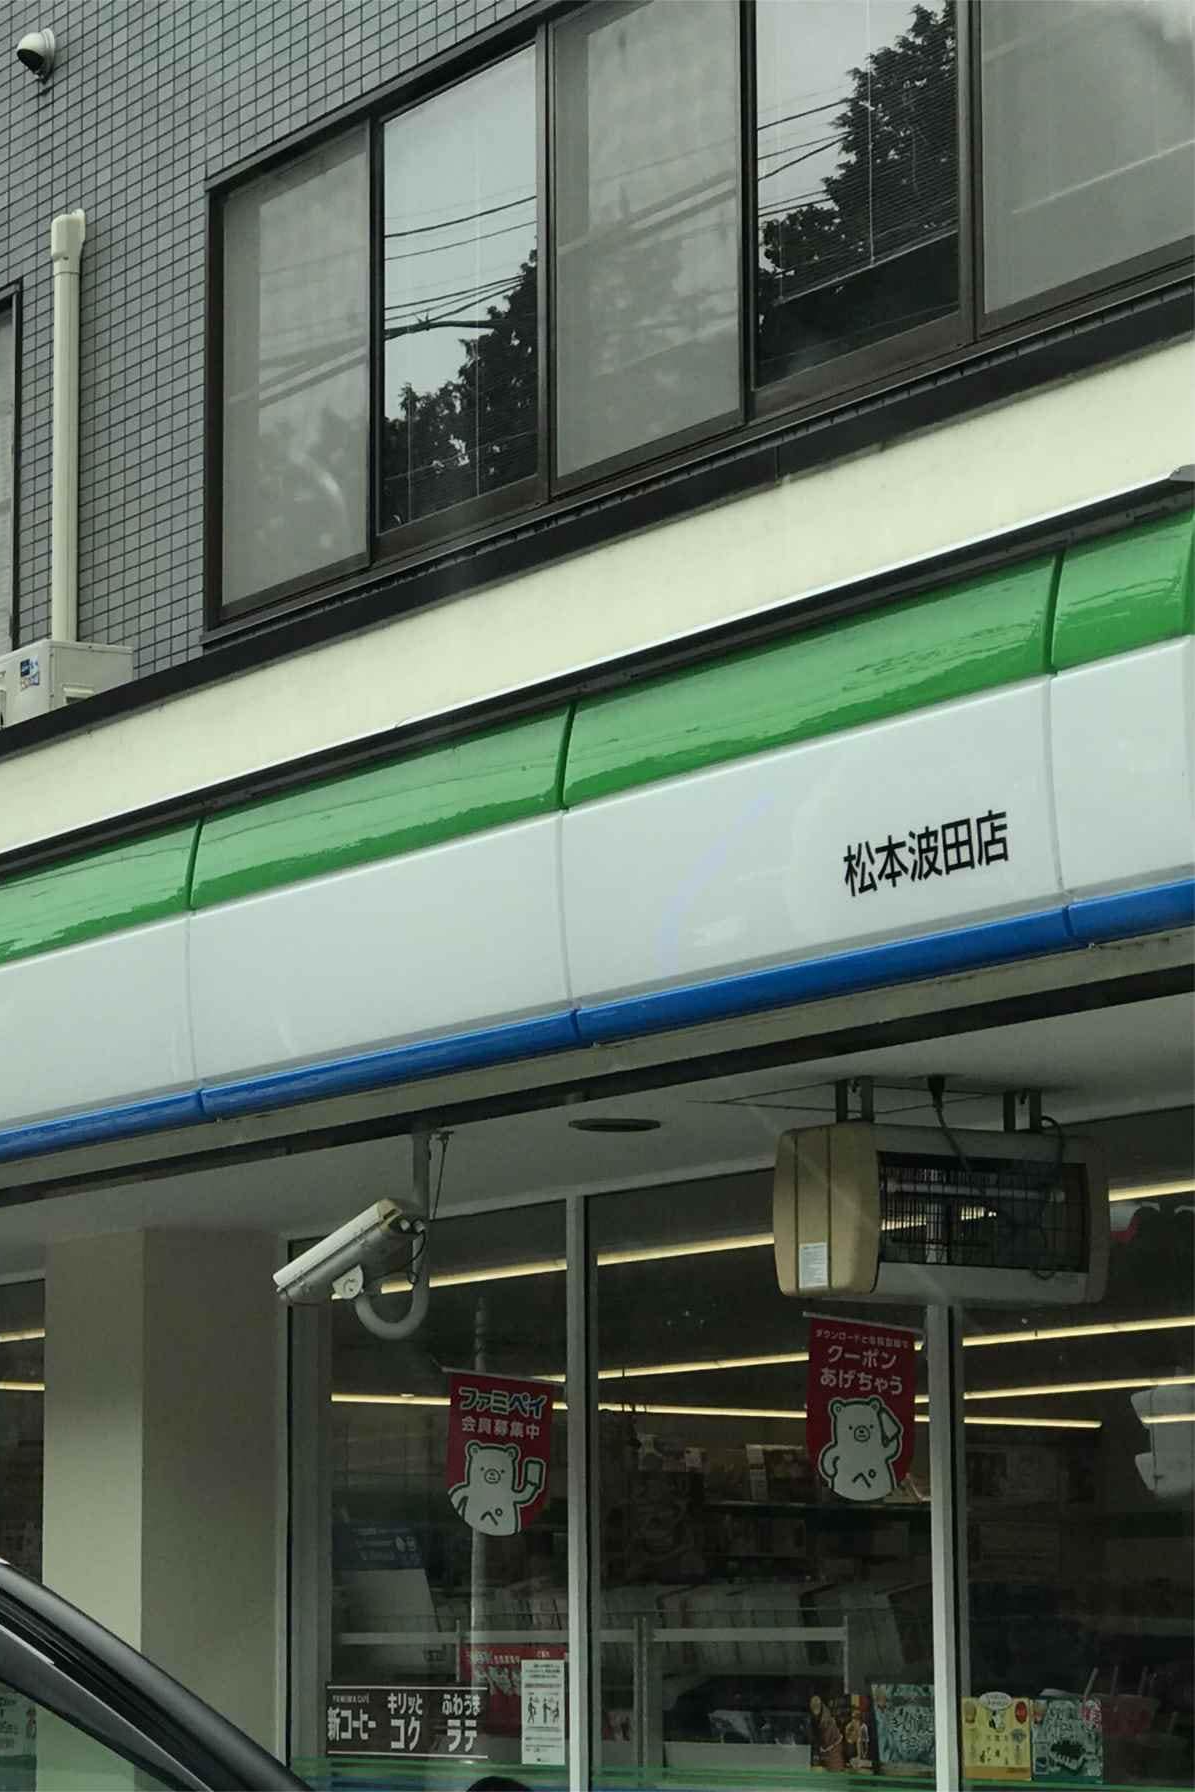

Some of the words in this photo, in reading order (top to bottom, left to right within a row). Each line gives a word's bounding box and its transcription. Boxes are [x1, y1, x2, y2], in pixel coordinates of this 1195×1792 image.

[843, 809, 1009, 897] 松本波田店
[827, 1344, 897, 1370] クーポン
[819, 1367, 903, 1395] あげちゃう
[458, 1386, 548, 1419] ファミペイ
[461, 1416, 541, 1440] 会員募集中
[387, 1692, 423, 1715] キリッと
[441, 1693, 481, 1716] ふわうま
[327, 1706, 377, 1741] 新コーヒー
[390, 1717, 422, 1752] コク
[446, 1718, 478, 1752] ラテ
